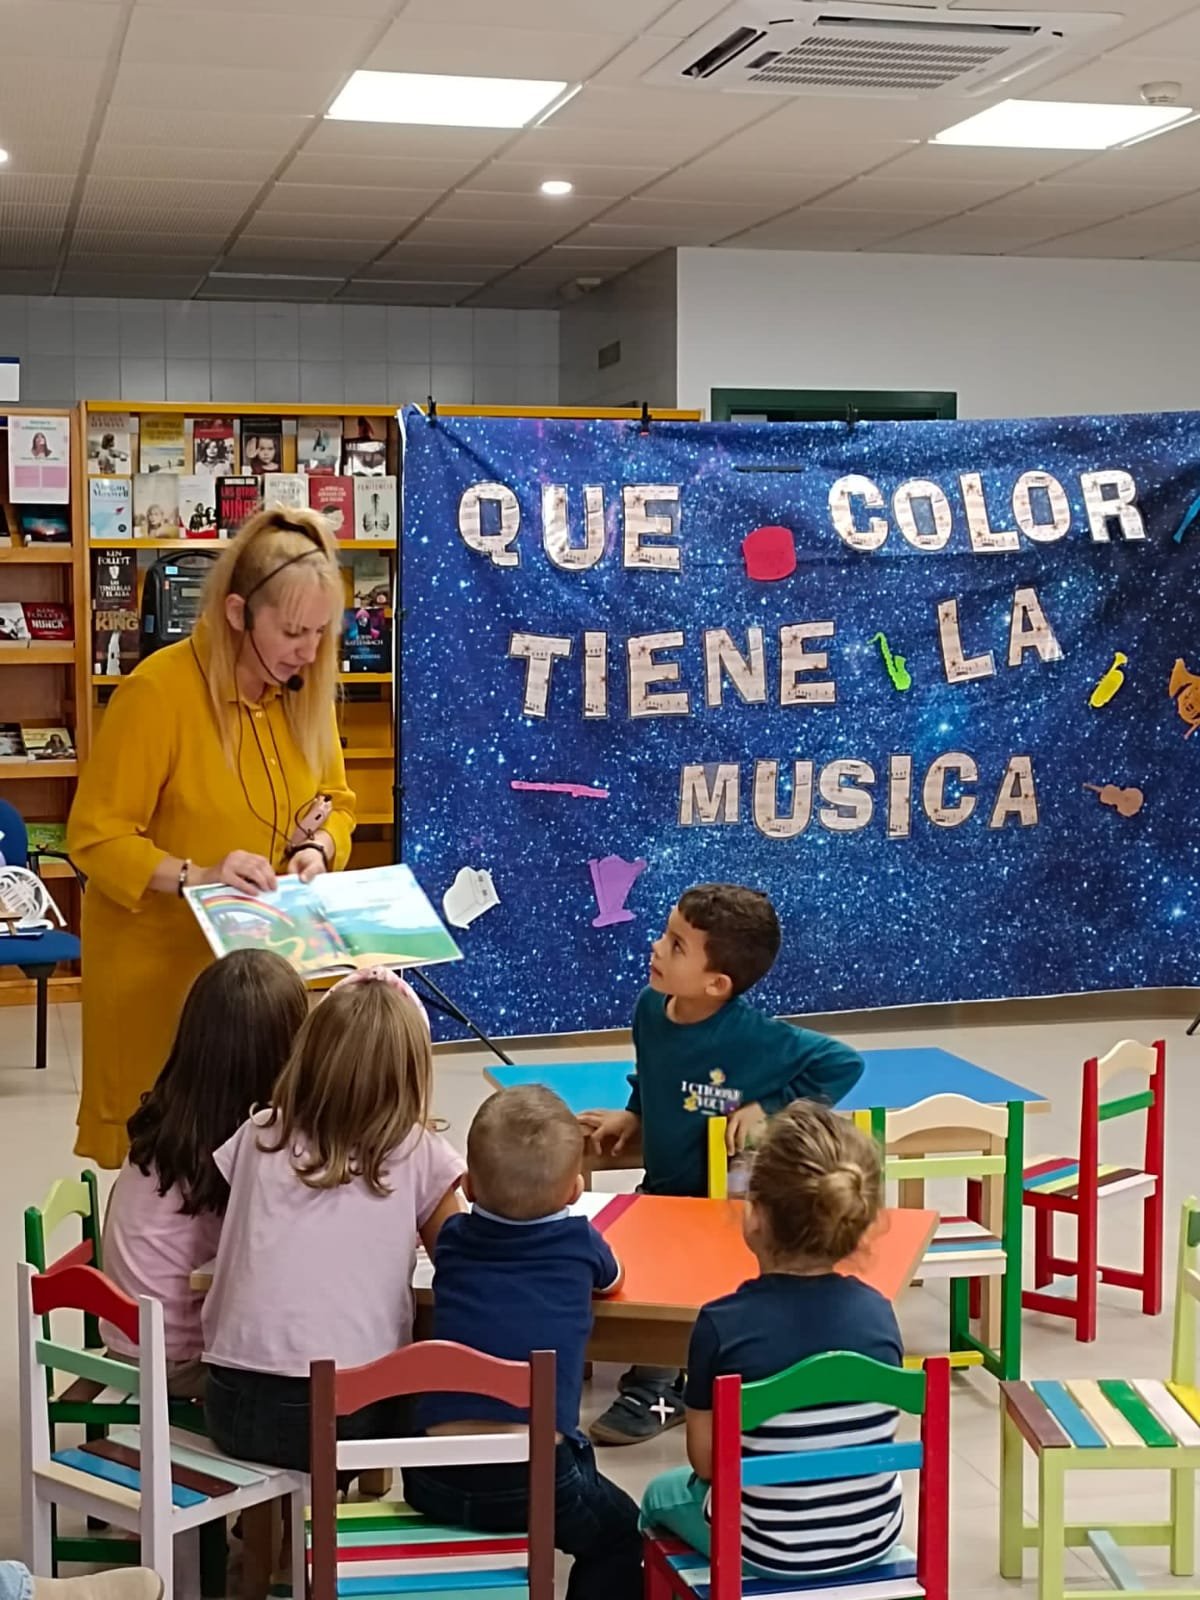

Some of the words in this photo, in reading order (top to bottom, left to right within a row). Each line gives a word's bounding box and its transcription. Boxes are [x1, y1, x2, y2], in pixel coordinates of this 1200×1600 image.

[458, 481, 682, 570] QUE
[828, 469, 1146, 552] COLOR
[98, 556, 131, 565] FOLLETT
[32, 620, 64, 629] NUNCA
[96, 618, 139, 631] KING
[510, 620, 836, 719] TIENE
[937, 584, 1064, 684] LA
[678, 751, 1039, 840] MUSICA
